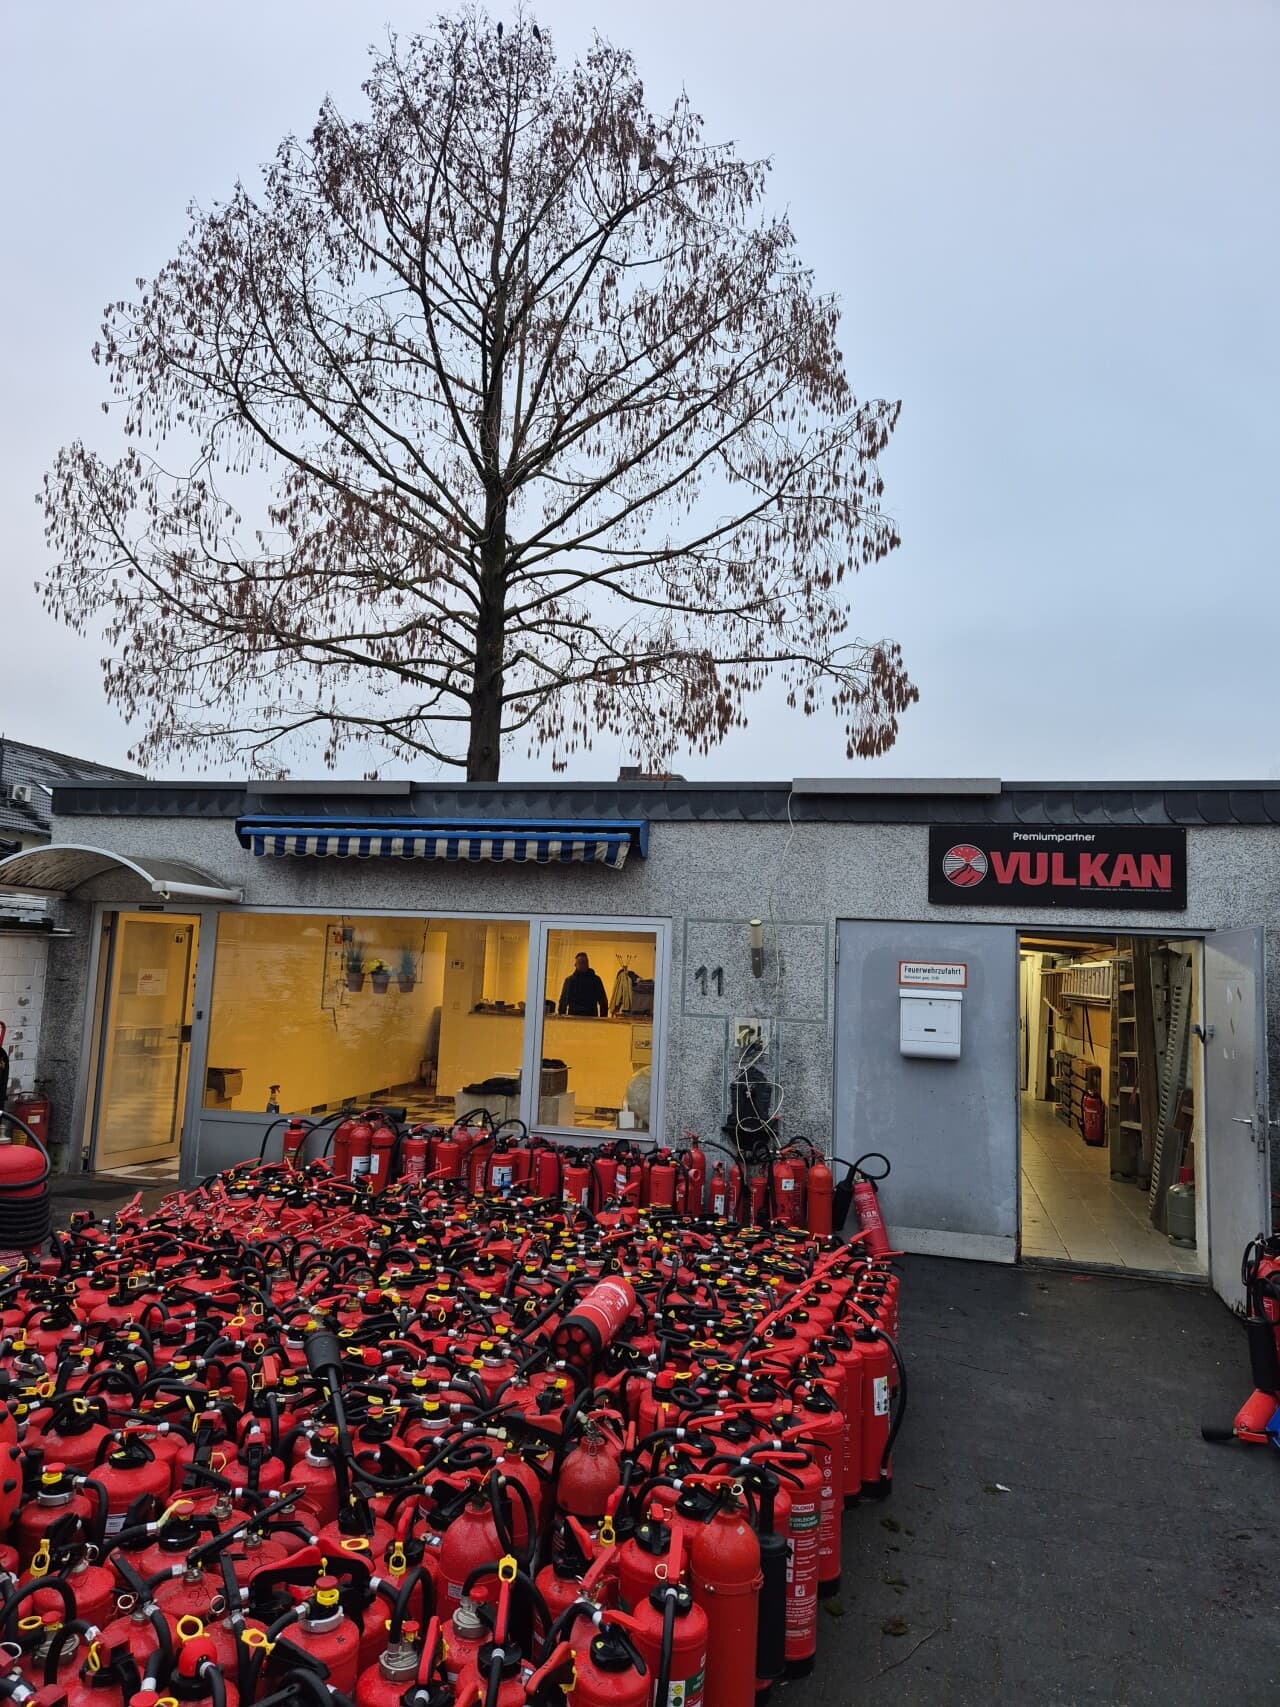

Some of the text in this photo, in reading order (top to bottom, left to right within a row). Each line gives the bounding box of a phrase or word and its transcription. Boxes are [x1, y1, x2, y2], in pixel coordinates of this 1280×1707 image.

[1013, 831, 1095, 843] Premiumpartner
[990, 851, 1172, 888] VULKAN
[904, 965, 961, 975] Feuerwehrzufahrt
[694, 965, 724, 997] 11
[793, 1504, 814, 1512] GLORIA
